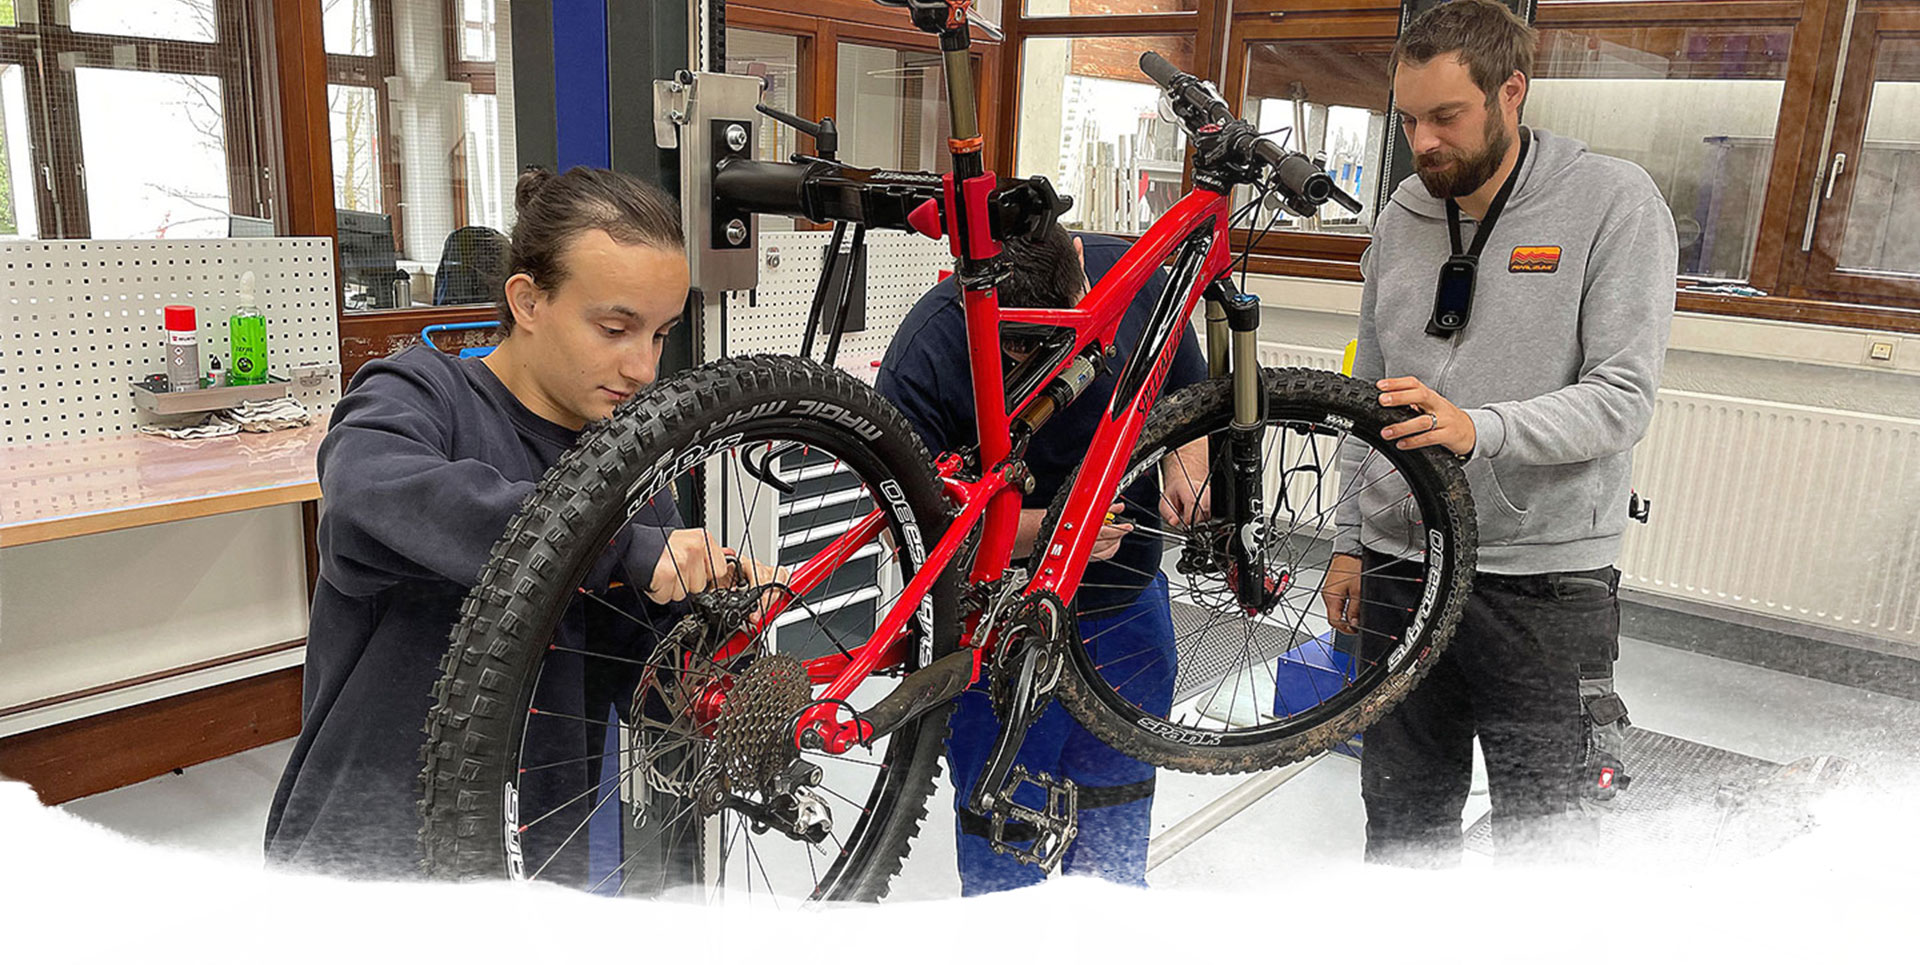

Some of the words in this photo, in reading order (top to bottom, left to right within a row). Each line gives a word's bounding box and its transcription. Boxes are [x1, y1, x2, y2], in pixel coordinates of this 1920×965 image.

[685, 400, 787, 449] MARY
[791, 400, 884, 441] MAGIC
[1051, 543, 1063, 556] M
